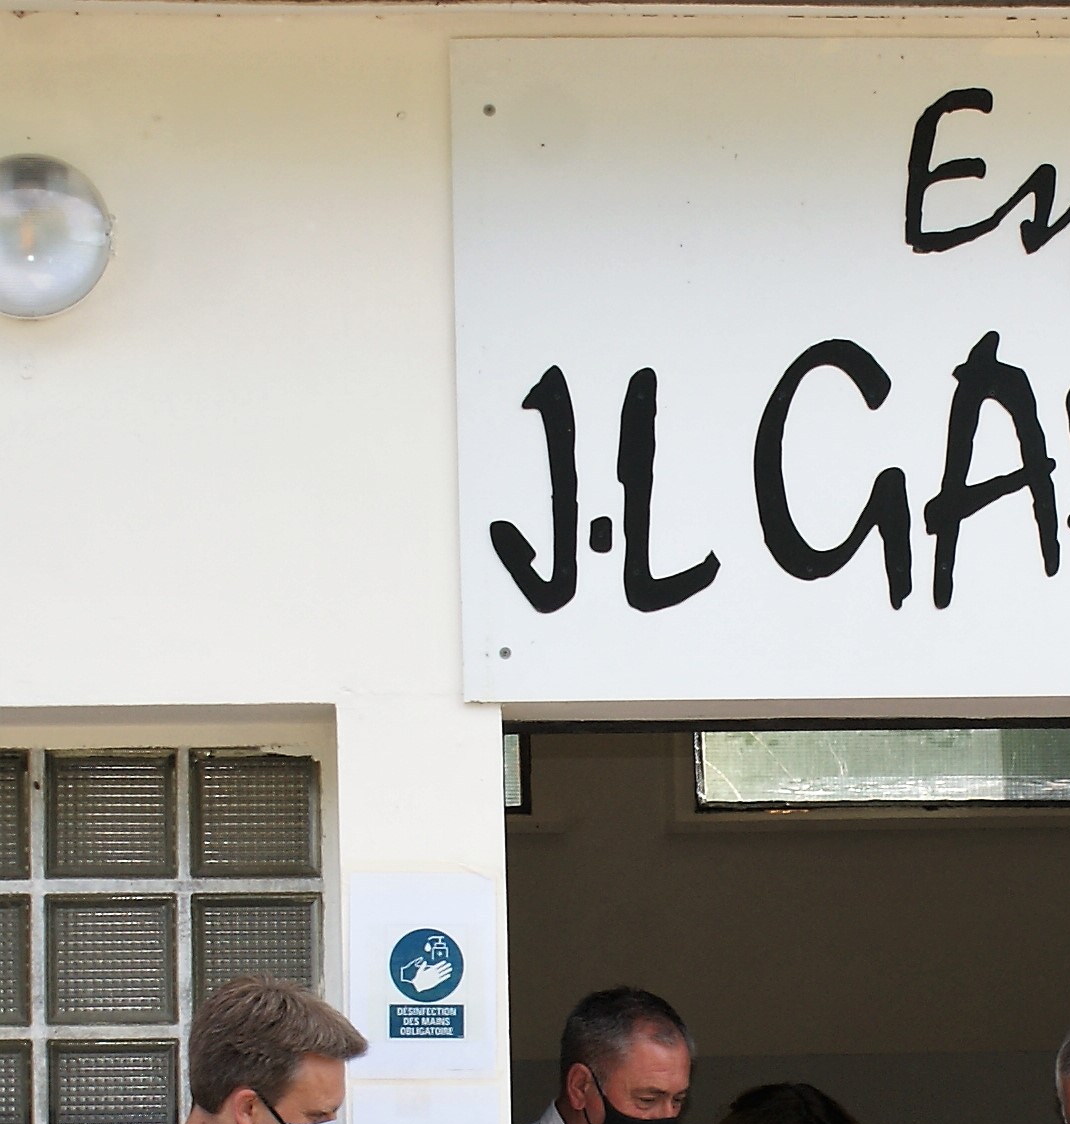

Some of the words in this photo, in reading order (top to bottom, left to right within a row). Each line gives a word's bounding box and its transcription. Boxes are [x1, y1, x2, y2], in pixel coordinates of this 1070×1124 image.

[403, 1017, 420, 1026] DES
[421, 1017, 450, 1026] MAINS
[400, 1026, 454, 1036] OBLIGATOIRE
